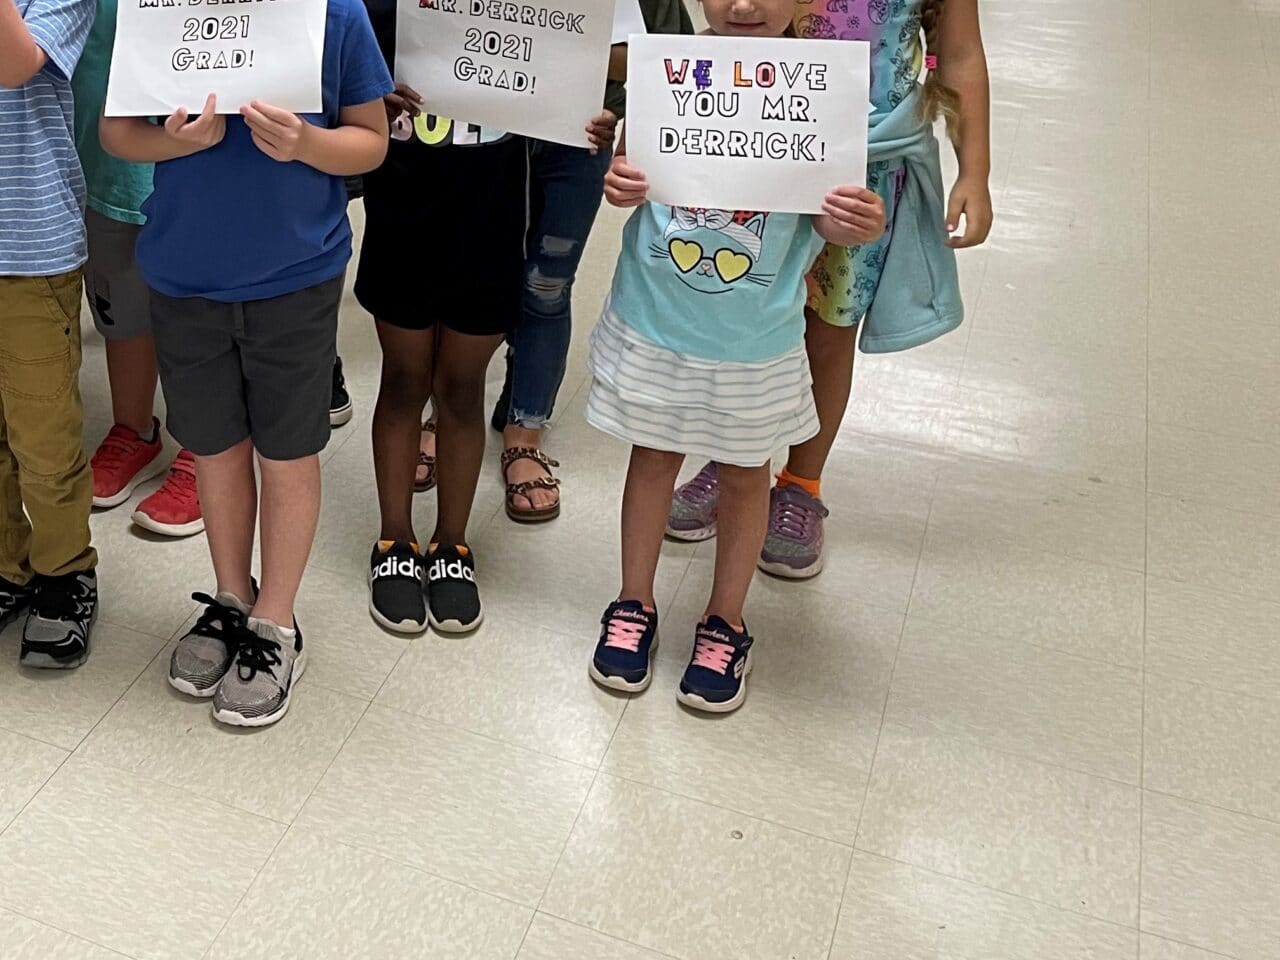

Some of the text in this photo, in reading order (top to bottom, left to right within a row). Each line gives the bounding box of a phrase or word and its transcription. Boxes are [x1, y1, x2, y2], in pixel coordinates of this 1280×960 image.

[182, 15, 251, 41] 2021
[172, 48, 255, 72] GRAD!
[464, 28, 533, 62] 2021
[454, 57, 536, 94] GRAD!
[664, 58, 827, 91] WE LOVE
[672, 90, 817, 123] YOU MR.
[660, 127, 825, 162] DERRICK!
